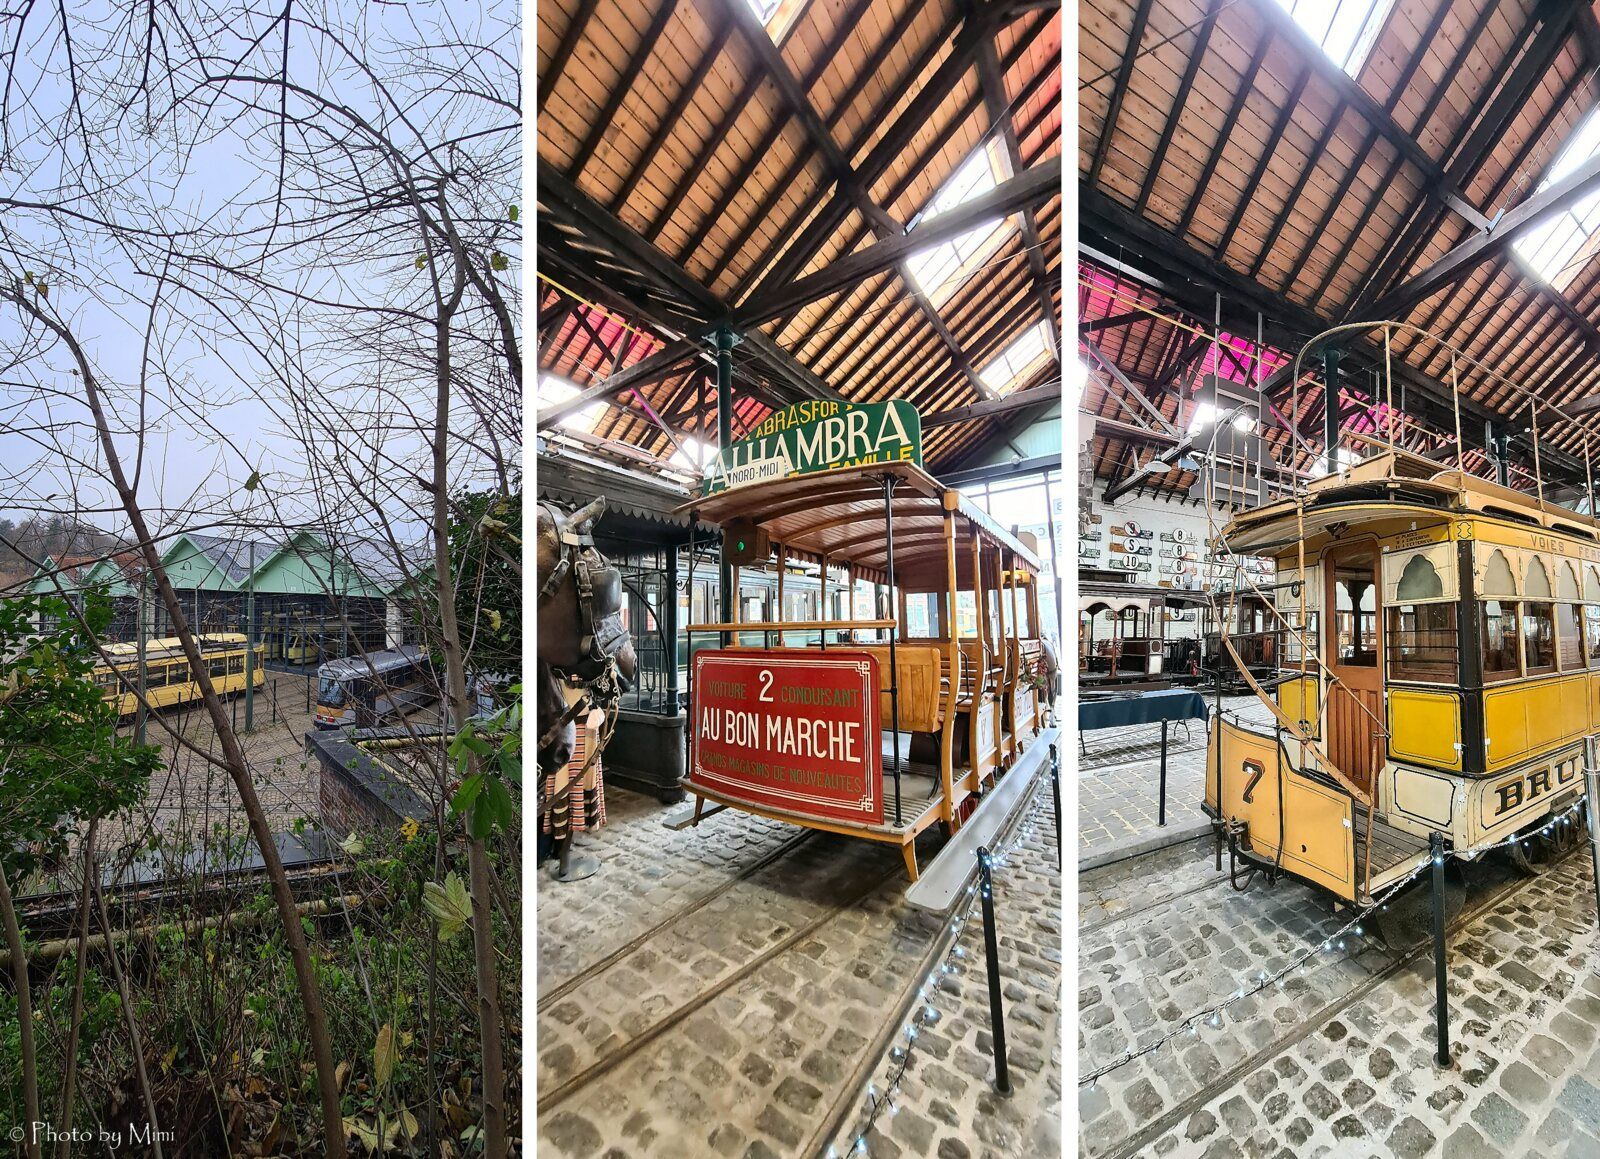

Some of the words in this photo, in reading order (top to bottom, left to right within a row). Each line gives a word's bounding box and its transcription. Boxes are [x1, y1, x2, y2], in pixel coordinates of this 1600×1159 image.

[756, 401, 839, 438] ABRASFOR
[1126, 555, 1137, 567] 10
[1530, 534, 1565, 553] VOIES
[708, 681, 747, 700] VOITURE
[758, 669, 774, 702] 2
[781, 685, 859, 708] CONDUISANT
[701, 706, 720, 741] AU
[725, 709, 760, 751] BON
[766, 714, 861, 763] MARCHE
[727, 757, 770, 780] MAGASINS
[773, 766, 785, 781] DE
[789, 769, 863, 794] NOUVEAUTES
[1241, 757, 1266, 804] 7
[1495, 749, 1582, 817] BRU
